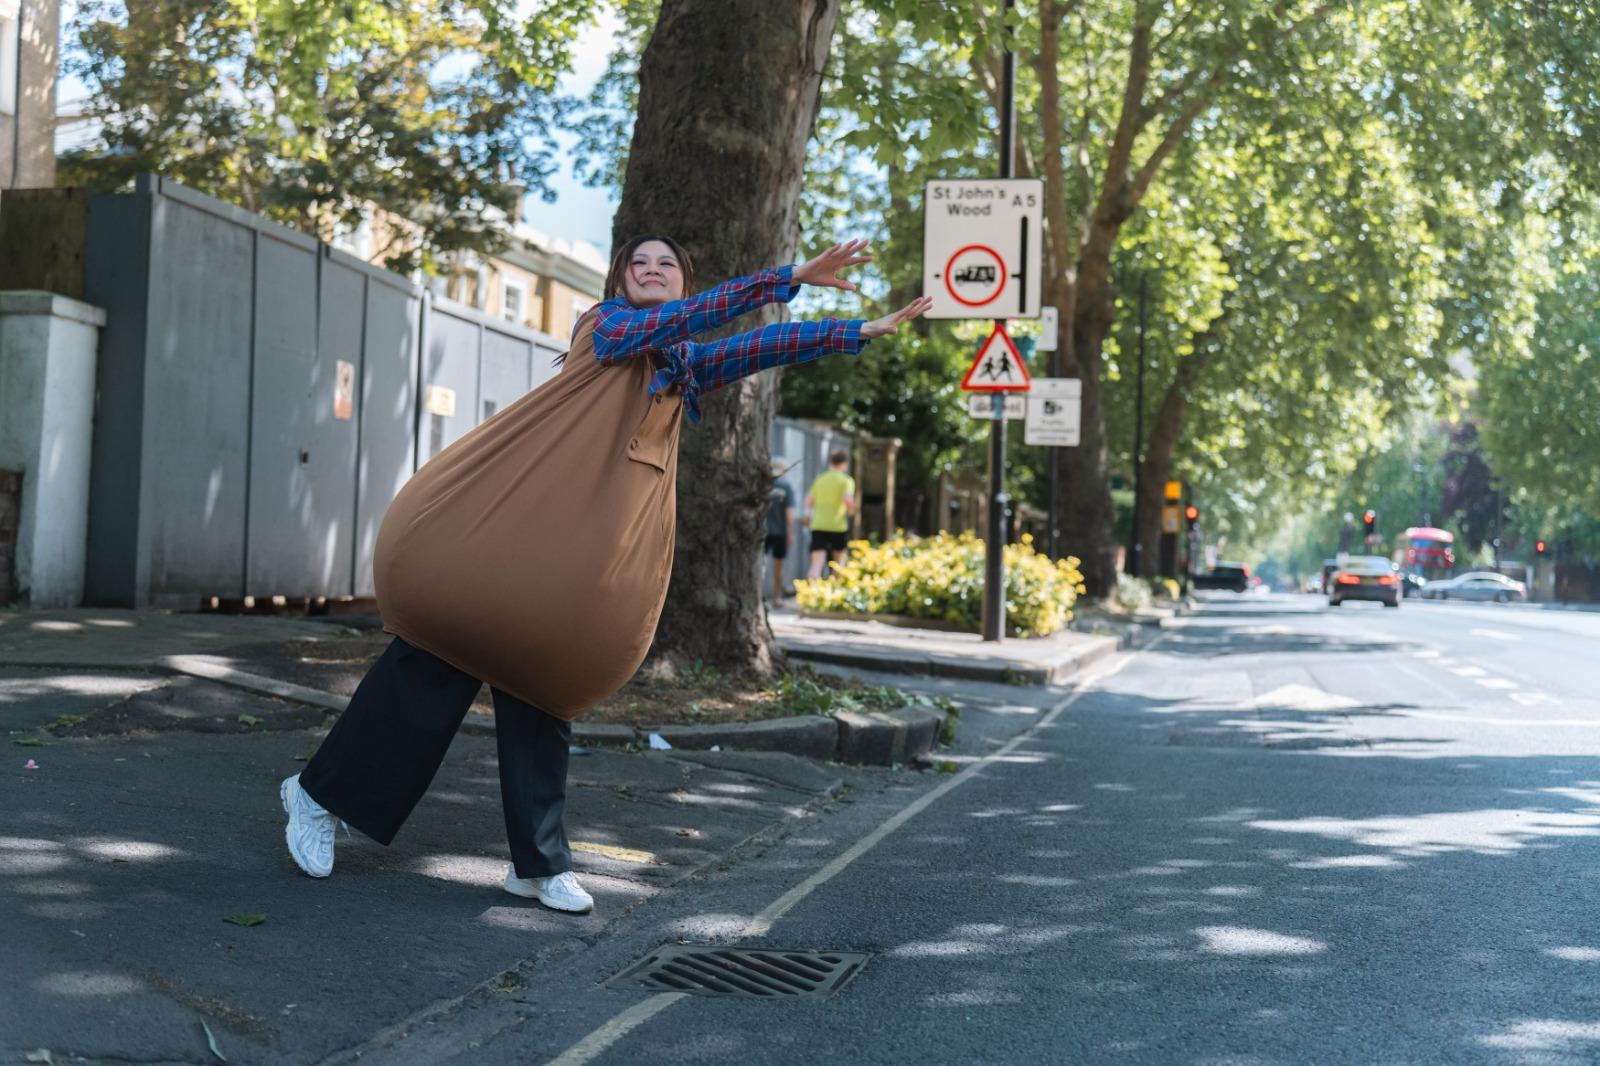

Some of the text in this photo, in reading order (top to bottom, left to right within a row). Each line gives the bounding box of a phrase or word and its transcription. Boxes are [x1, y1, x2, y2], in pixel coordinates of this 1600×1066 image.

[933, 186, 1006, 200] St John's
[947, 204, 992, 216] Wood
